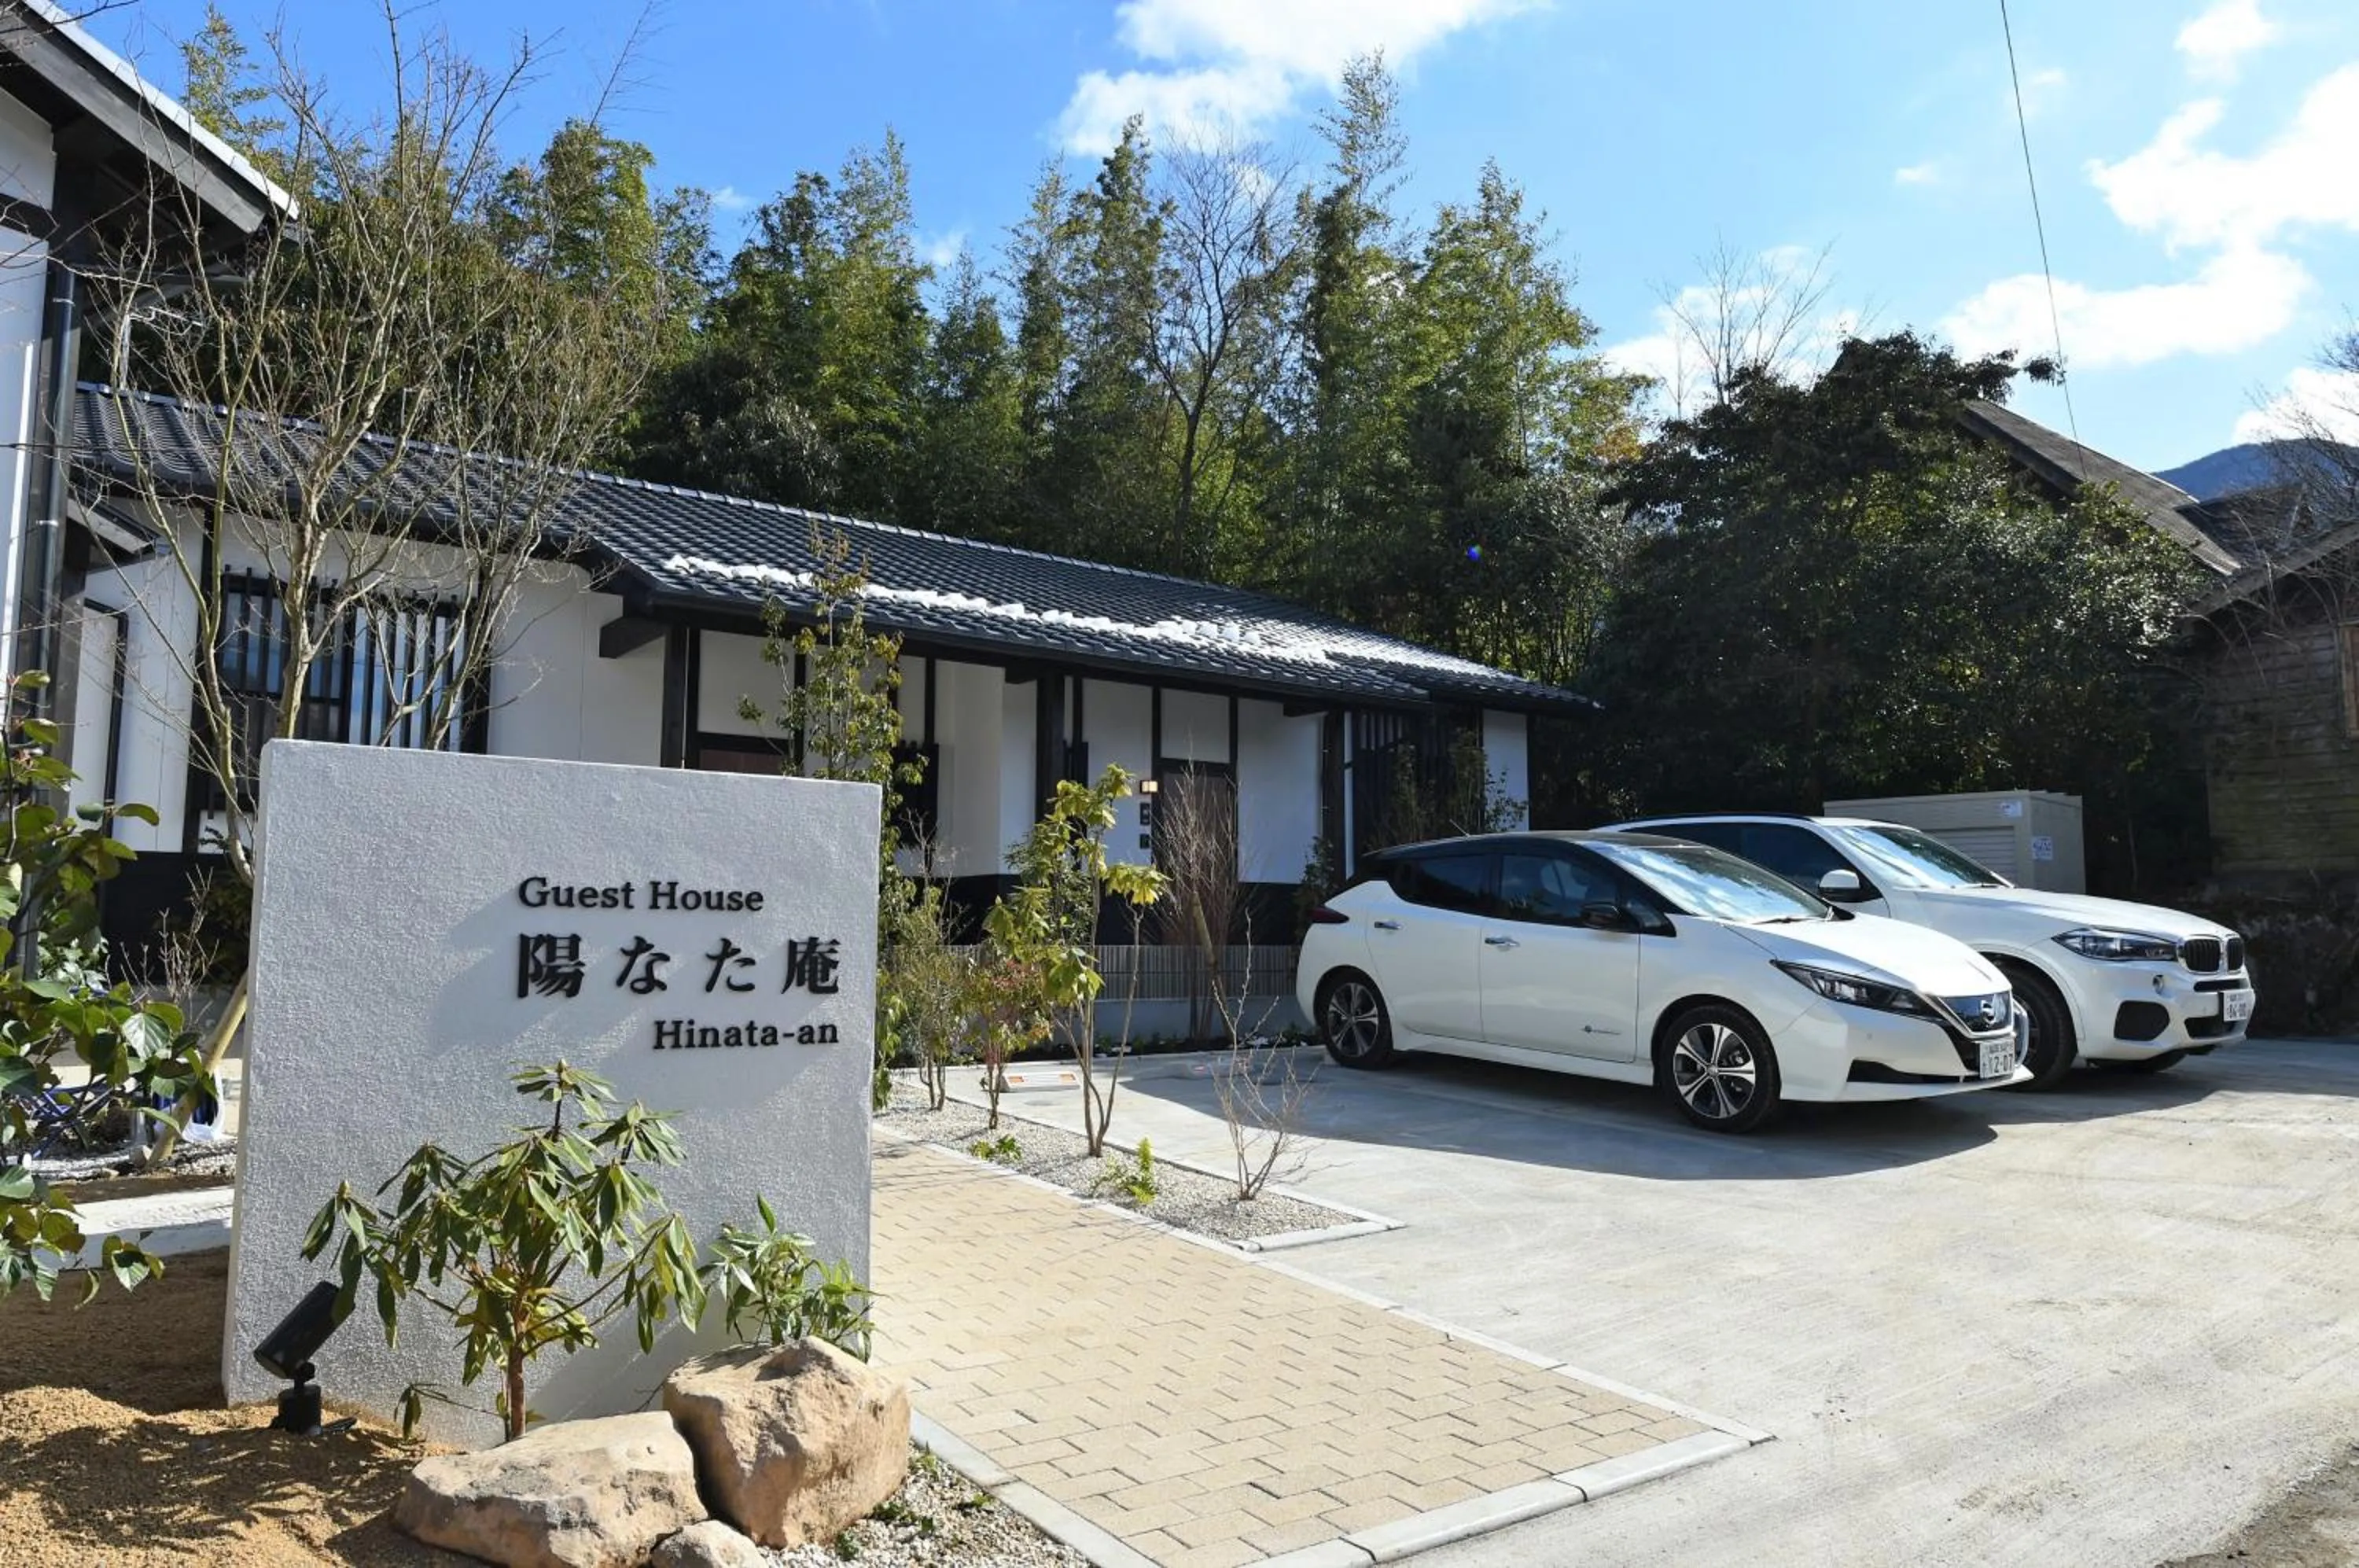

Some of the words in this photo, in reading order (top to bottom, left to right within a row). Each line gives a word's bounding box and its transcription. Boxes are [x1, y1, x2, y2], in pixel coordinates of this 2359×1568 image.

[517, 876, 635, 910] Guest
[648, 881, 764, 912] House
[517, 933, 841, 999] 陽なた庵
[652, 1018, 839, 1051] Hinata-an
